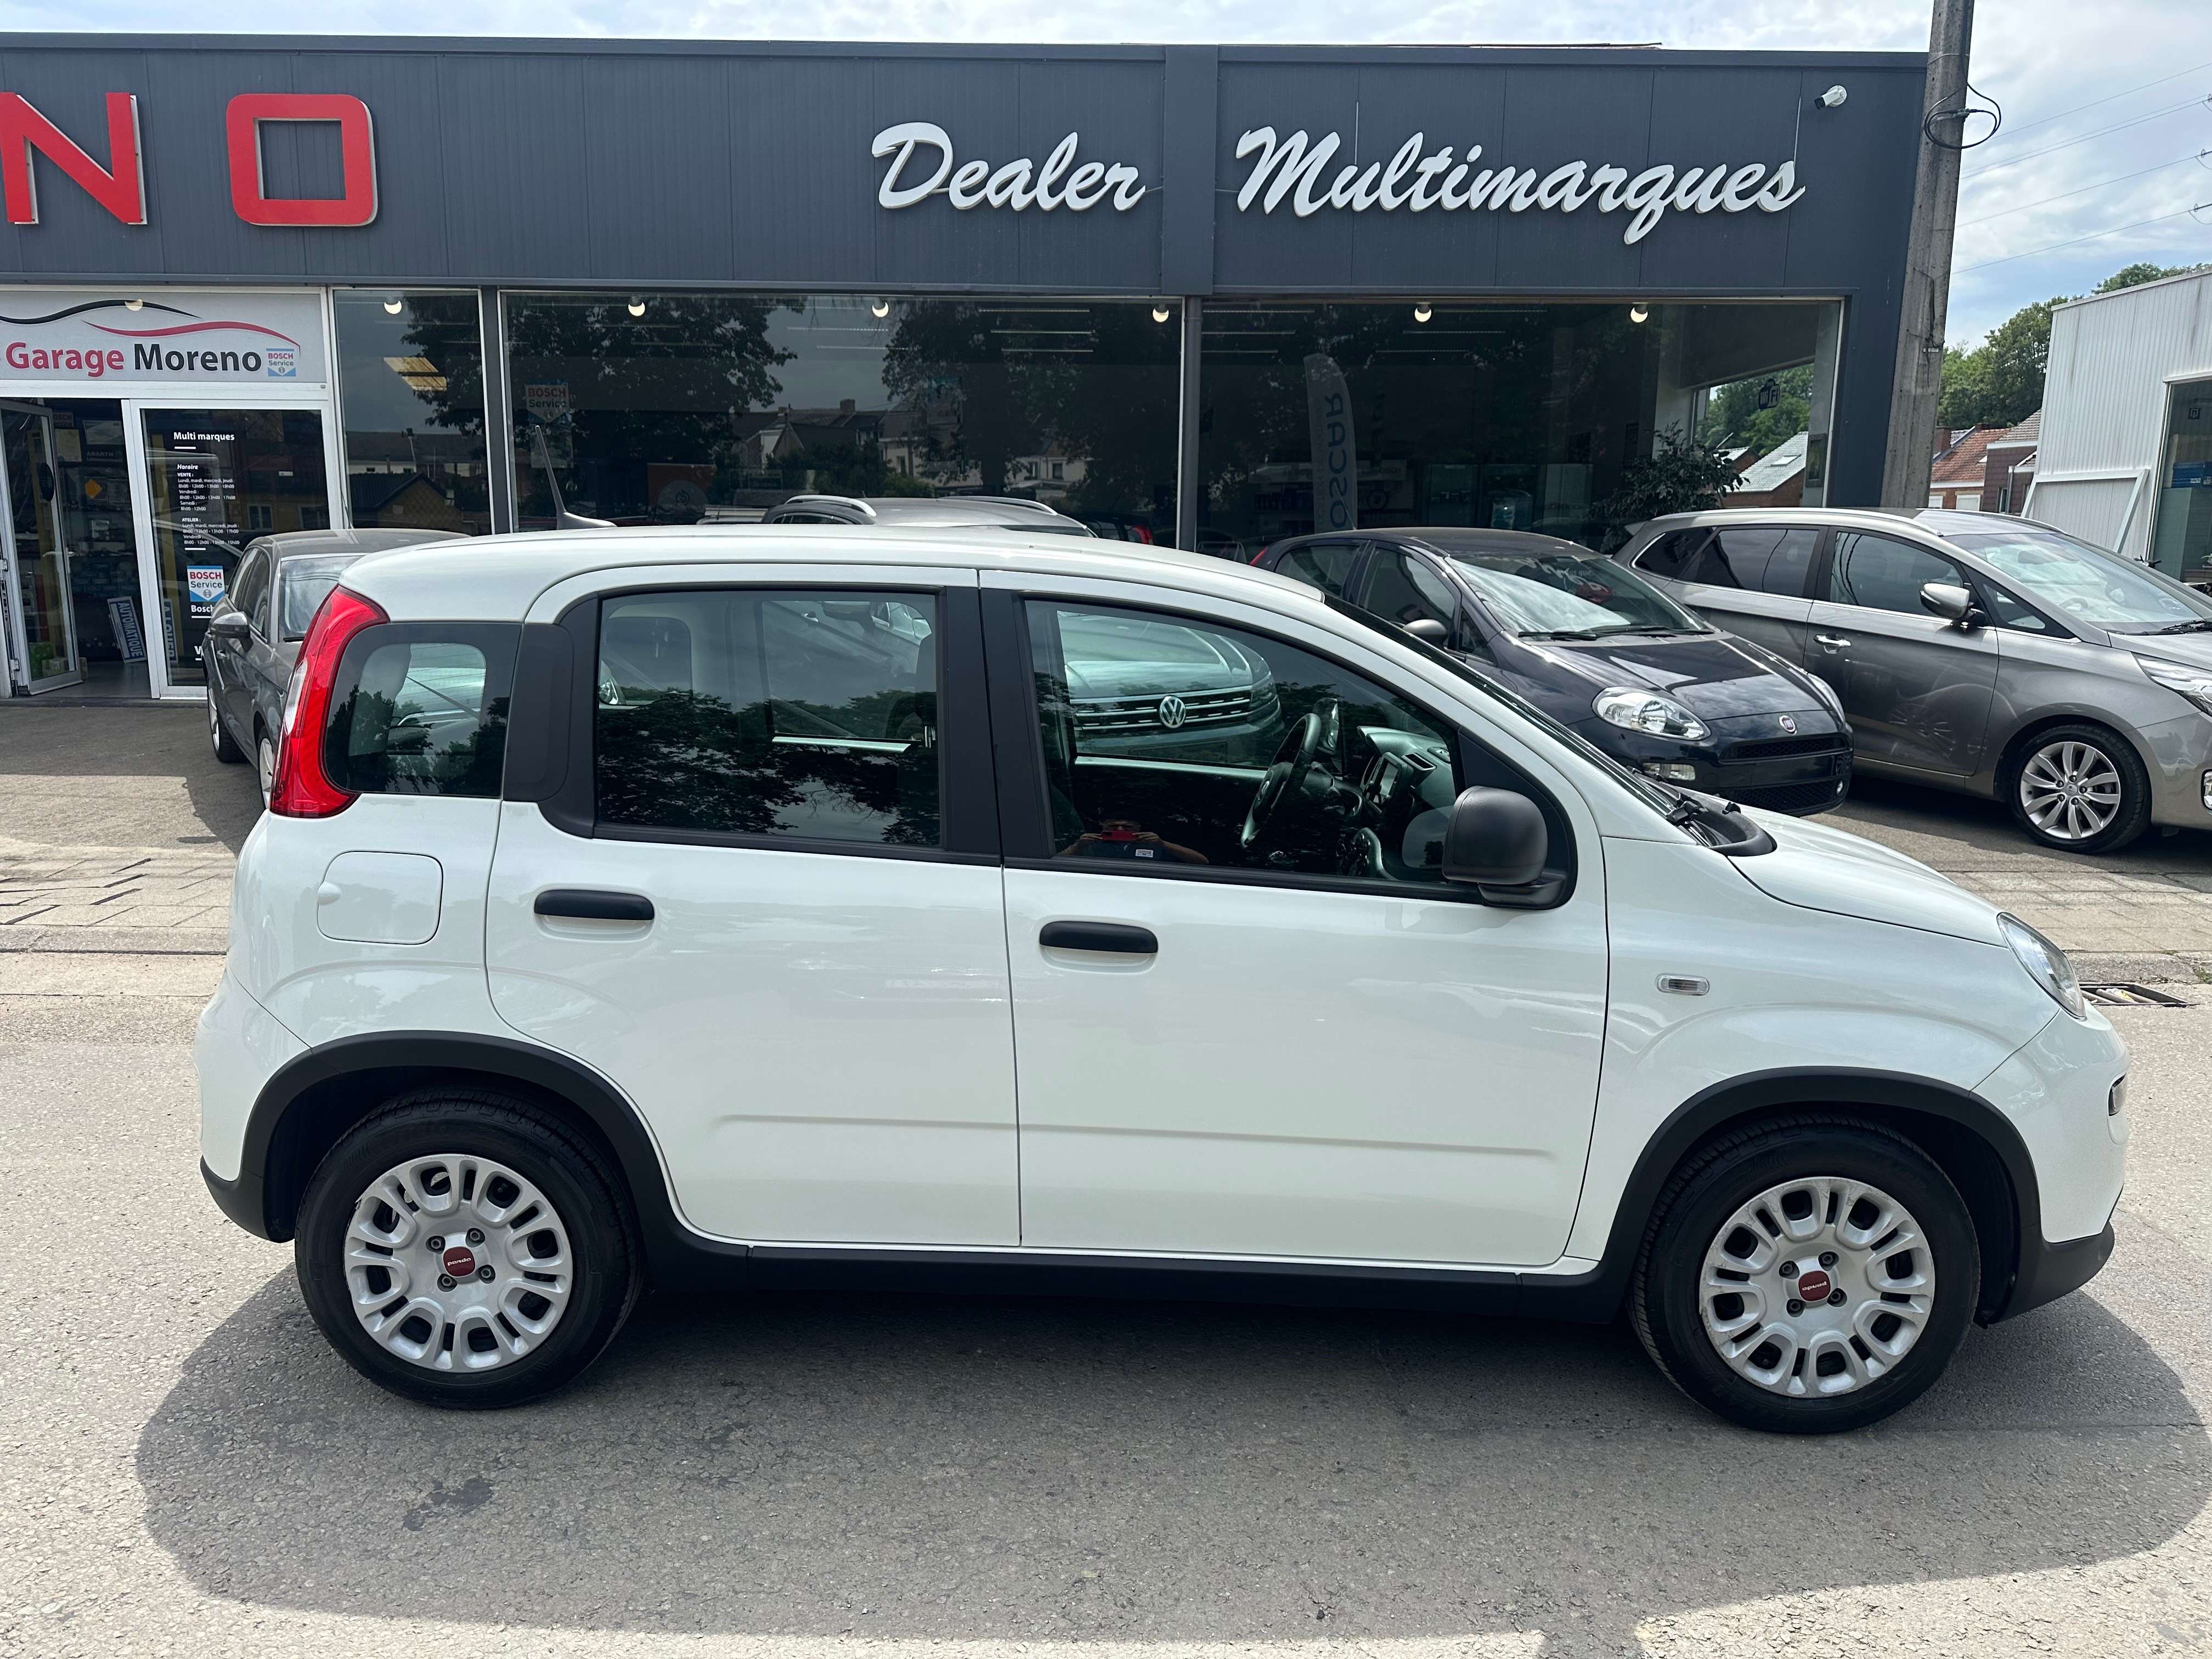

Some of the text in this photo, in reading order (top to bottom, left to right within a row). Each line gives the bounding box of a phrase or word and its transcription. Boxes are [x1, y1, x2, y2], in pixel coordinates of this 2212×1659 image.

[872, 122, 1805, 245] Dealer Multimarques
[5, 342, 262, 377] Garage Moreno
[528, 388, 566, 397] BOSCH
[529, 399, 567, 408] Service
[173, 432, 235, 442] Multi marques
[118, 602, 143, 657] AUTOMATIQUE
[447, 1257, 471, 1266] panda
[1802, 1281, 1827, 1291] panda
